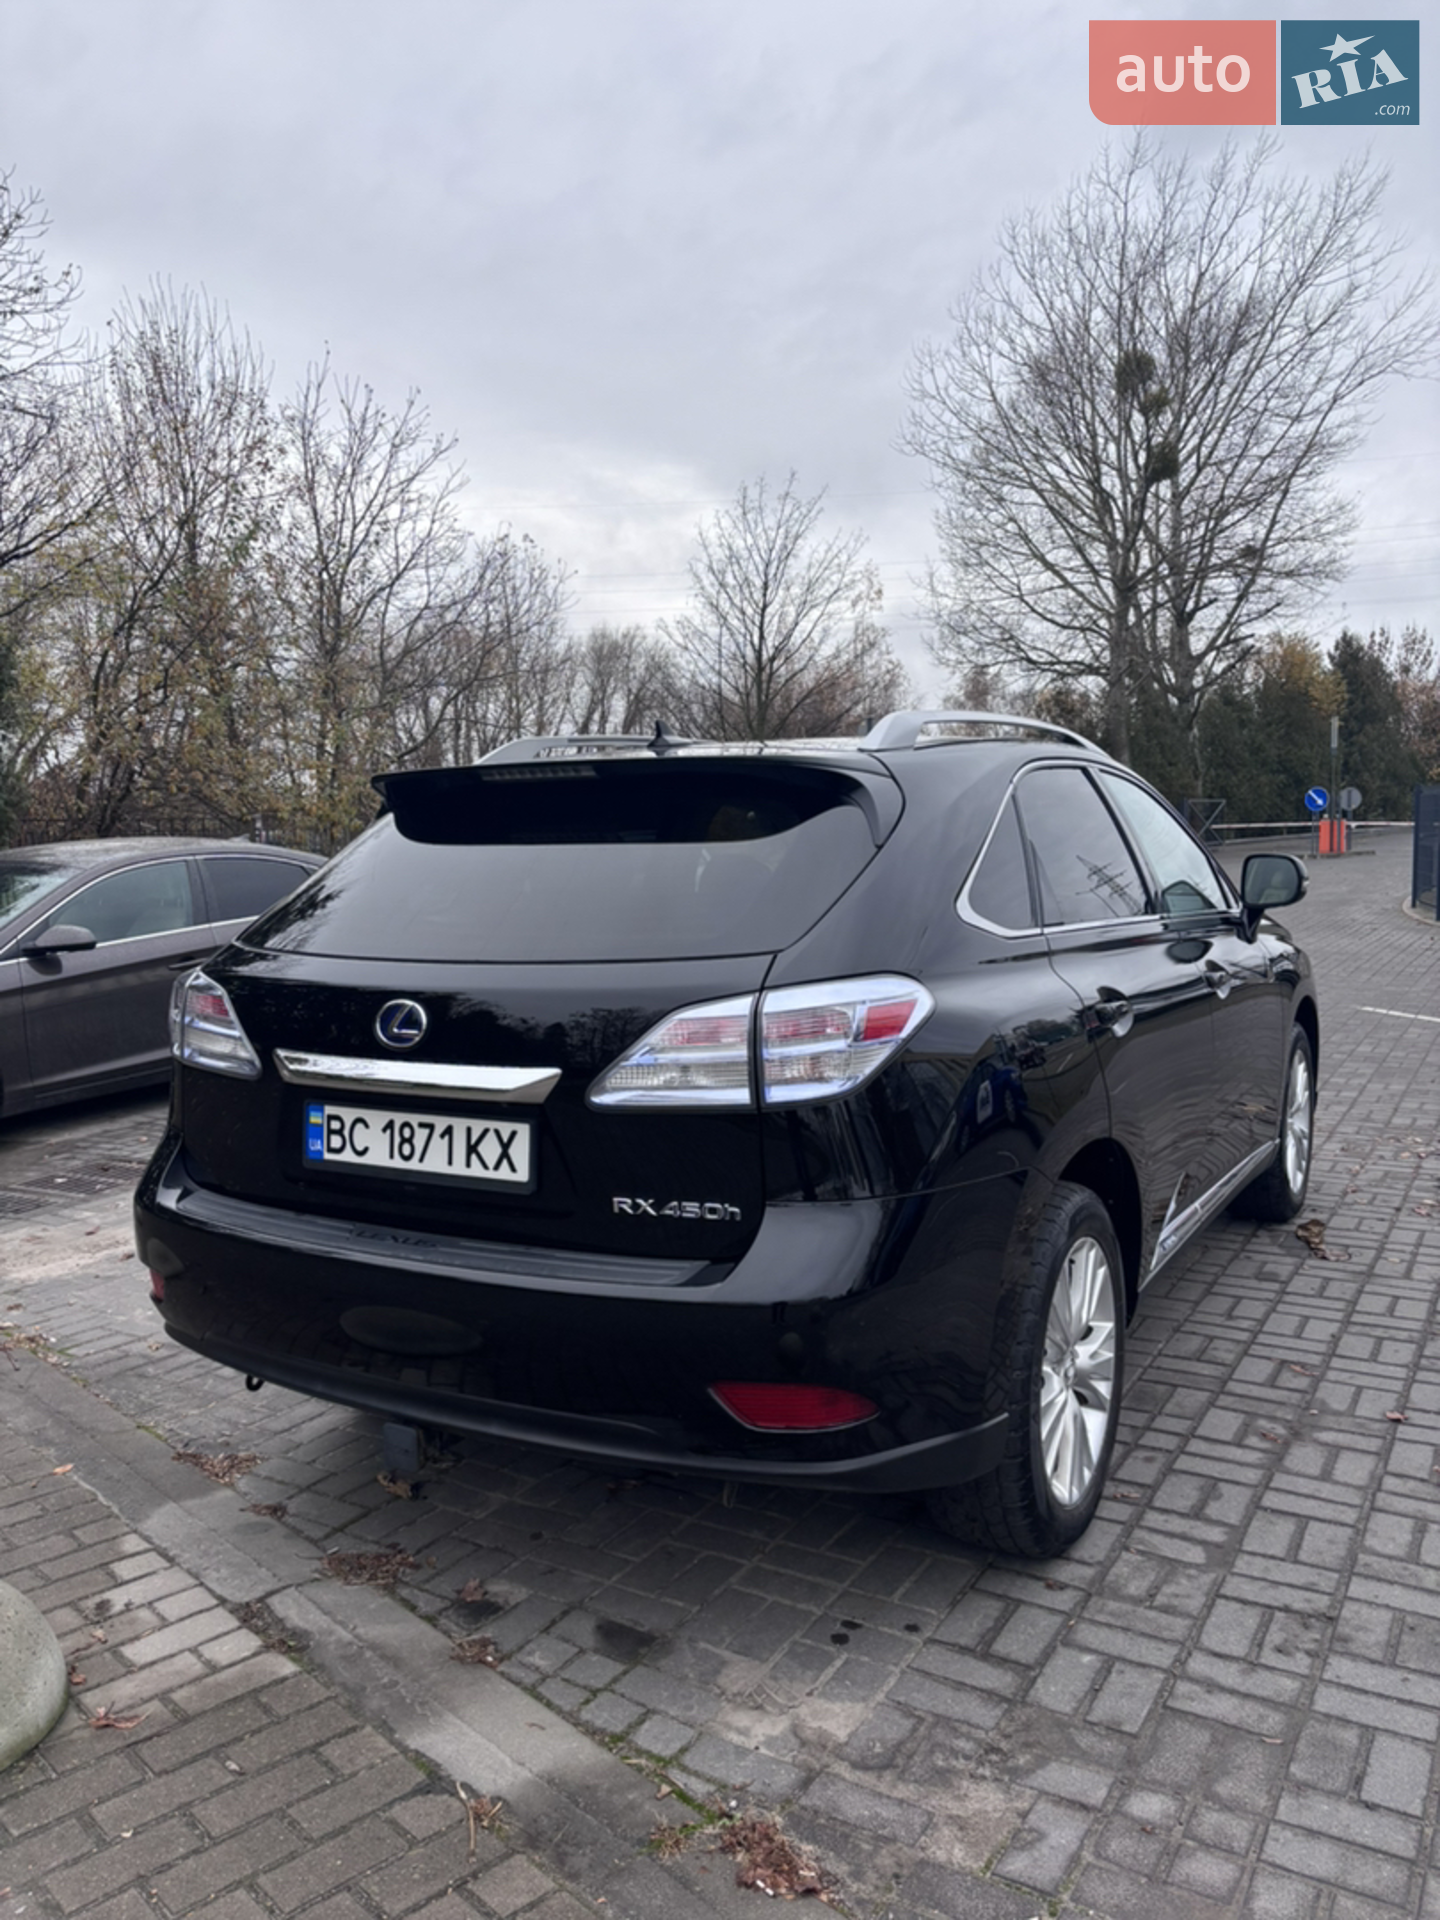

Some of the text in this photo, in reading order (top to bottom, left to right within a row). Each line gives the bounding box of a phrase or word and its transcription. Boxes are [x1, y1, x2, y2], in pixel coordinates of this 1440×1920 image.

[325, 1113, 519, 1174] BC 1871 KX
